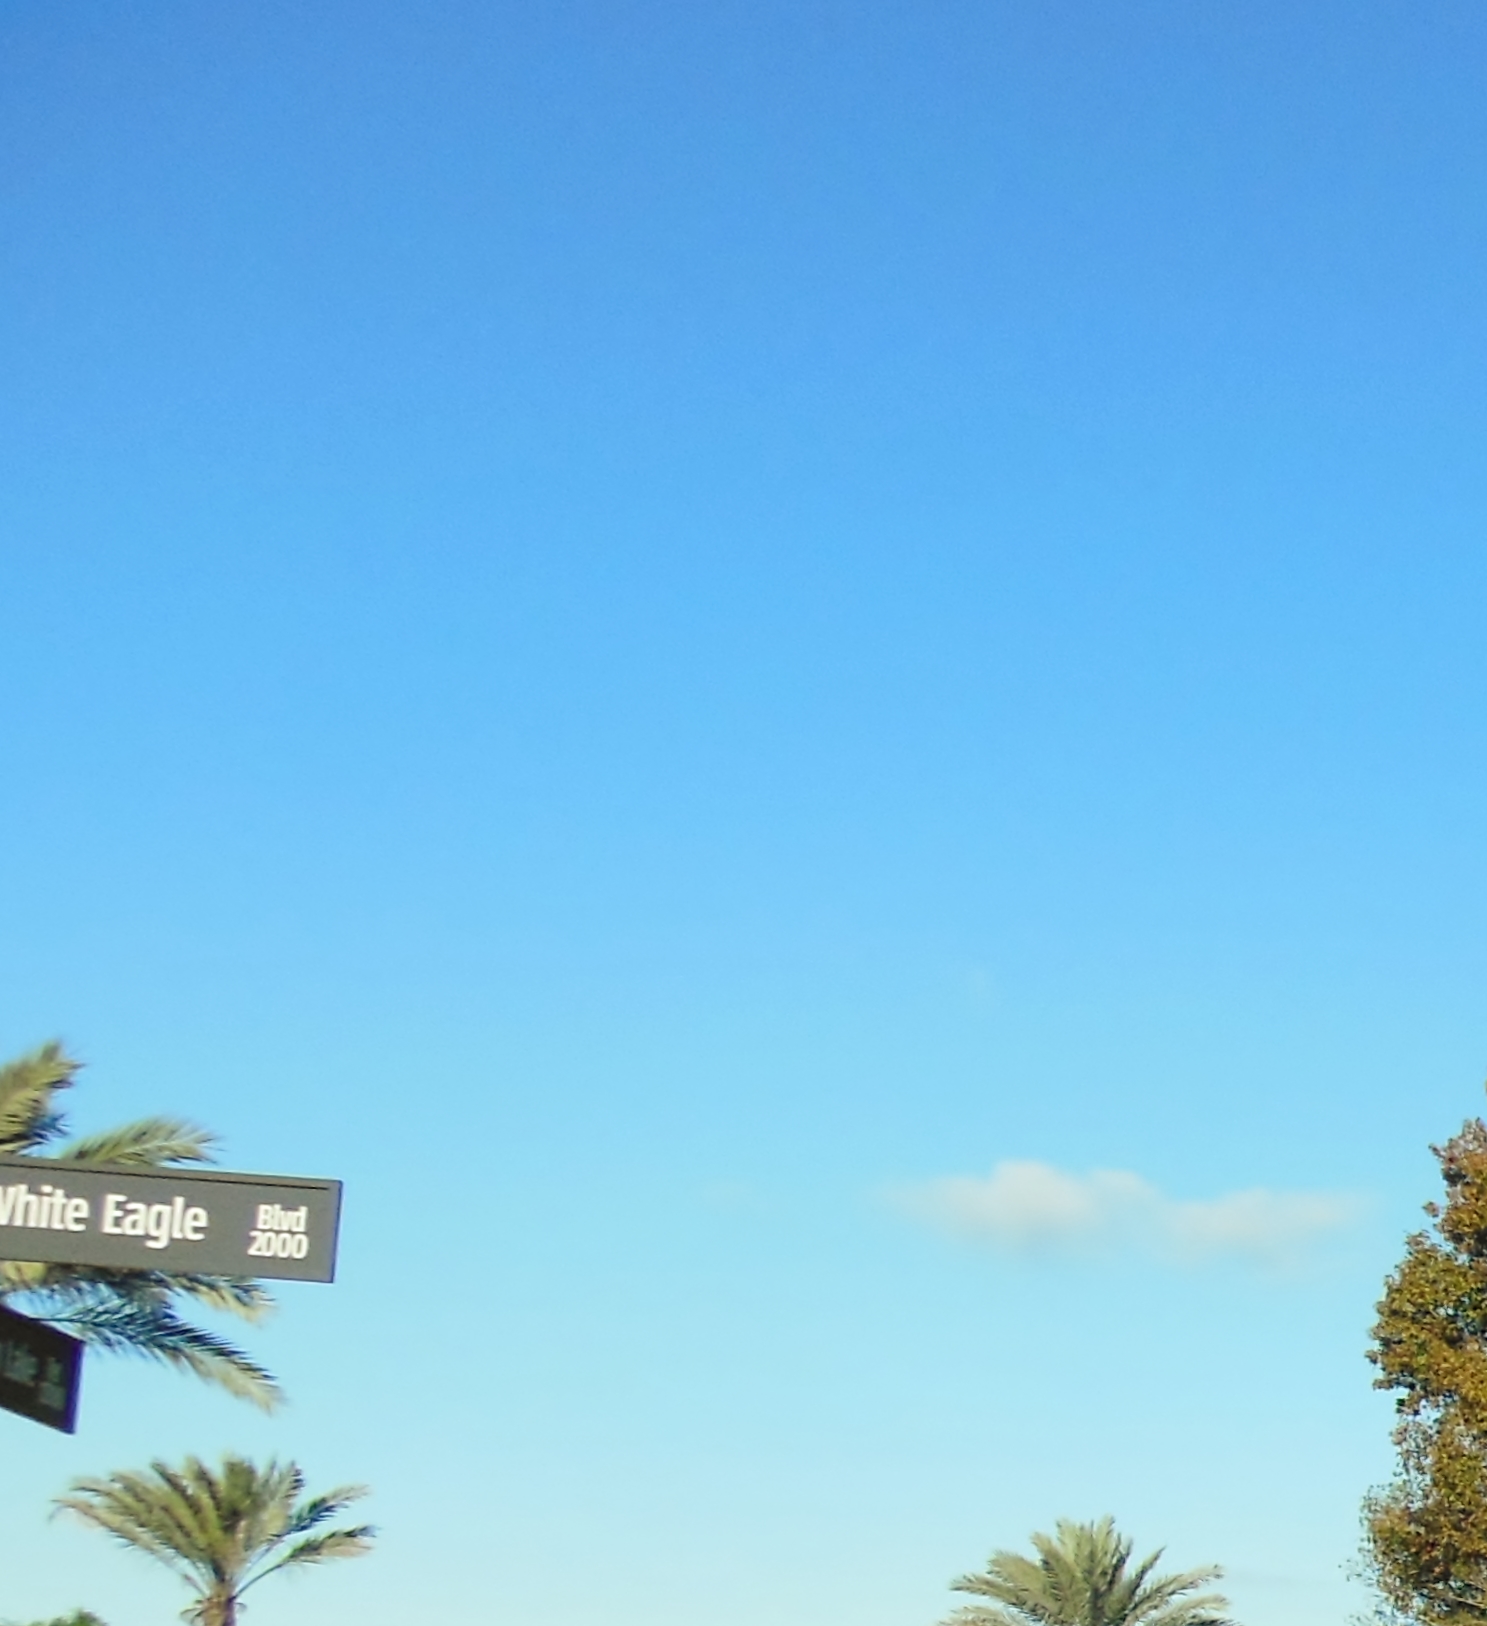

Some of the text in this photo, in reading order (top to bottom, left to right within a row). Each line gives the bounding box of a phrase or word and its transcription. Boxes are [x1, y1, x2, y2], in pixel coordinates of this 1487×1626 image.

[101, 1193, 209, 1250] Eagle
[255, 1203, 309, 1232] Blvd
[247, 1230, 310, 1260] 2000
